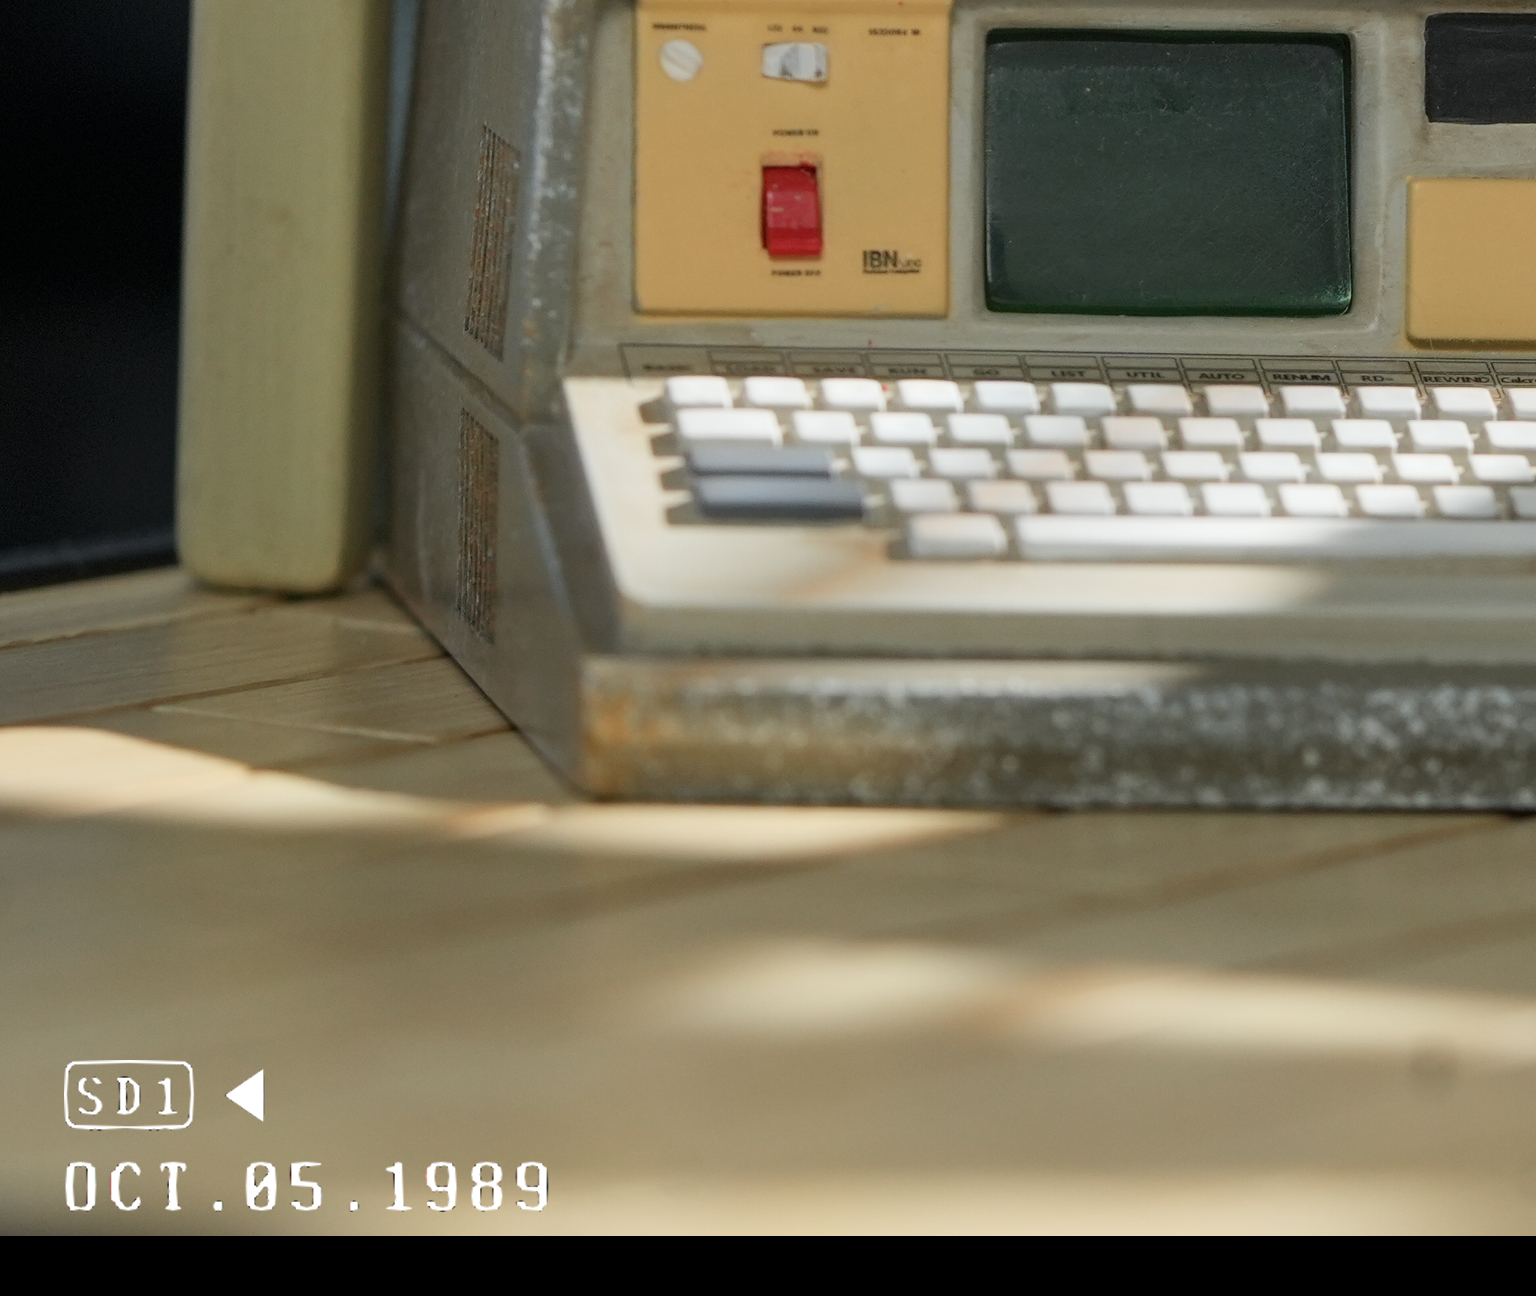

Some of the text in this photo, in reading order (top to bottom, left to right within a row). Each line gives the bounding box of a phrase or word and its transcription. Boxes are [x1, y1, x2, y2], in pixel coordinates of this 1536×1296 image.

[1050, 369, 1087, 378] LIST
[1125, 371, 1166, 379] UTIL
[1198, 372, 1246, 380] AUTO
[1272, 373, 1331, 382] RENUM
[1422, 375, 1490, 383] REWIND
